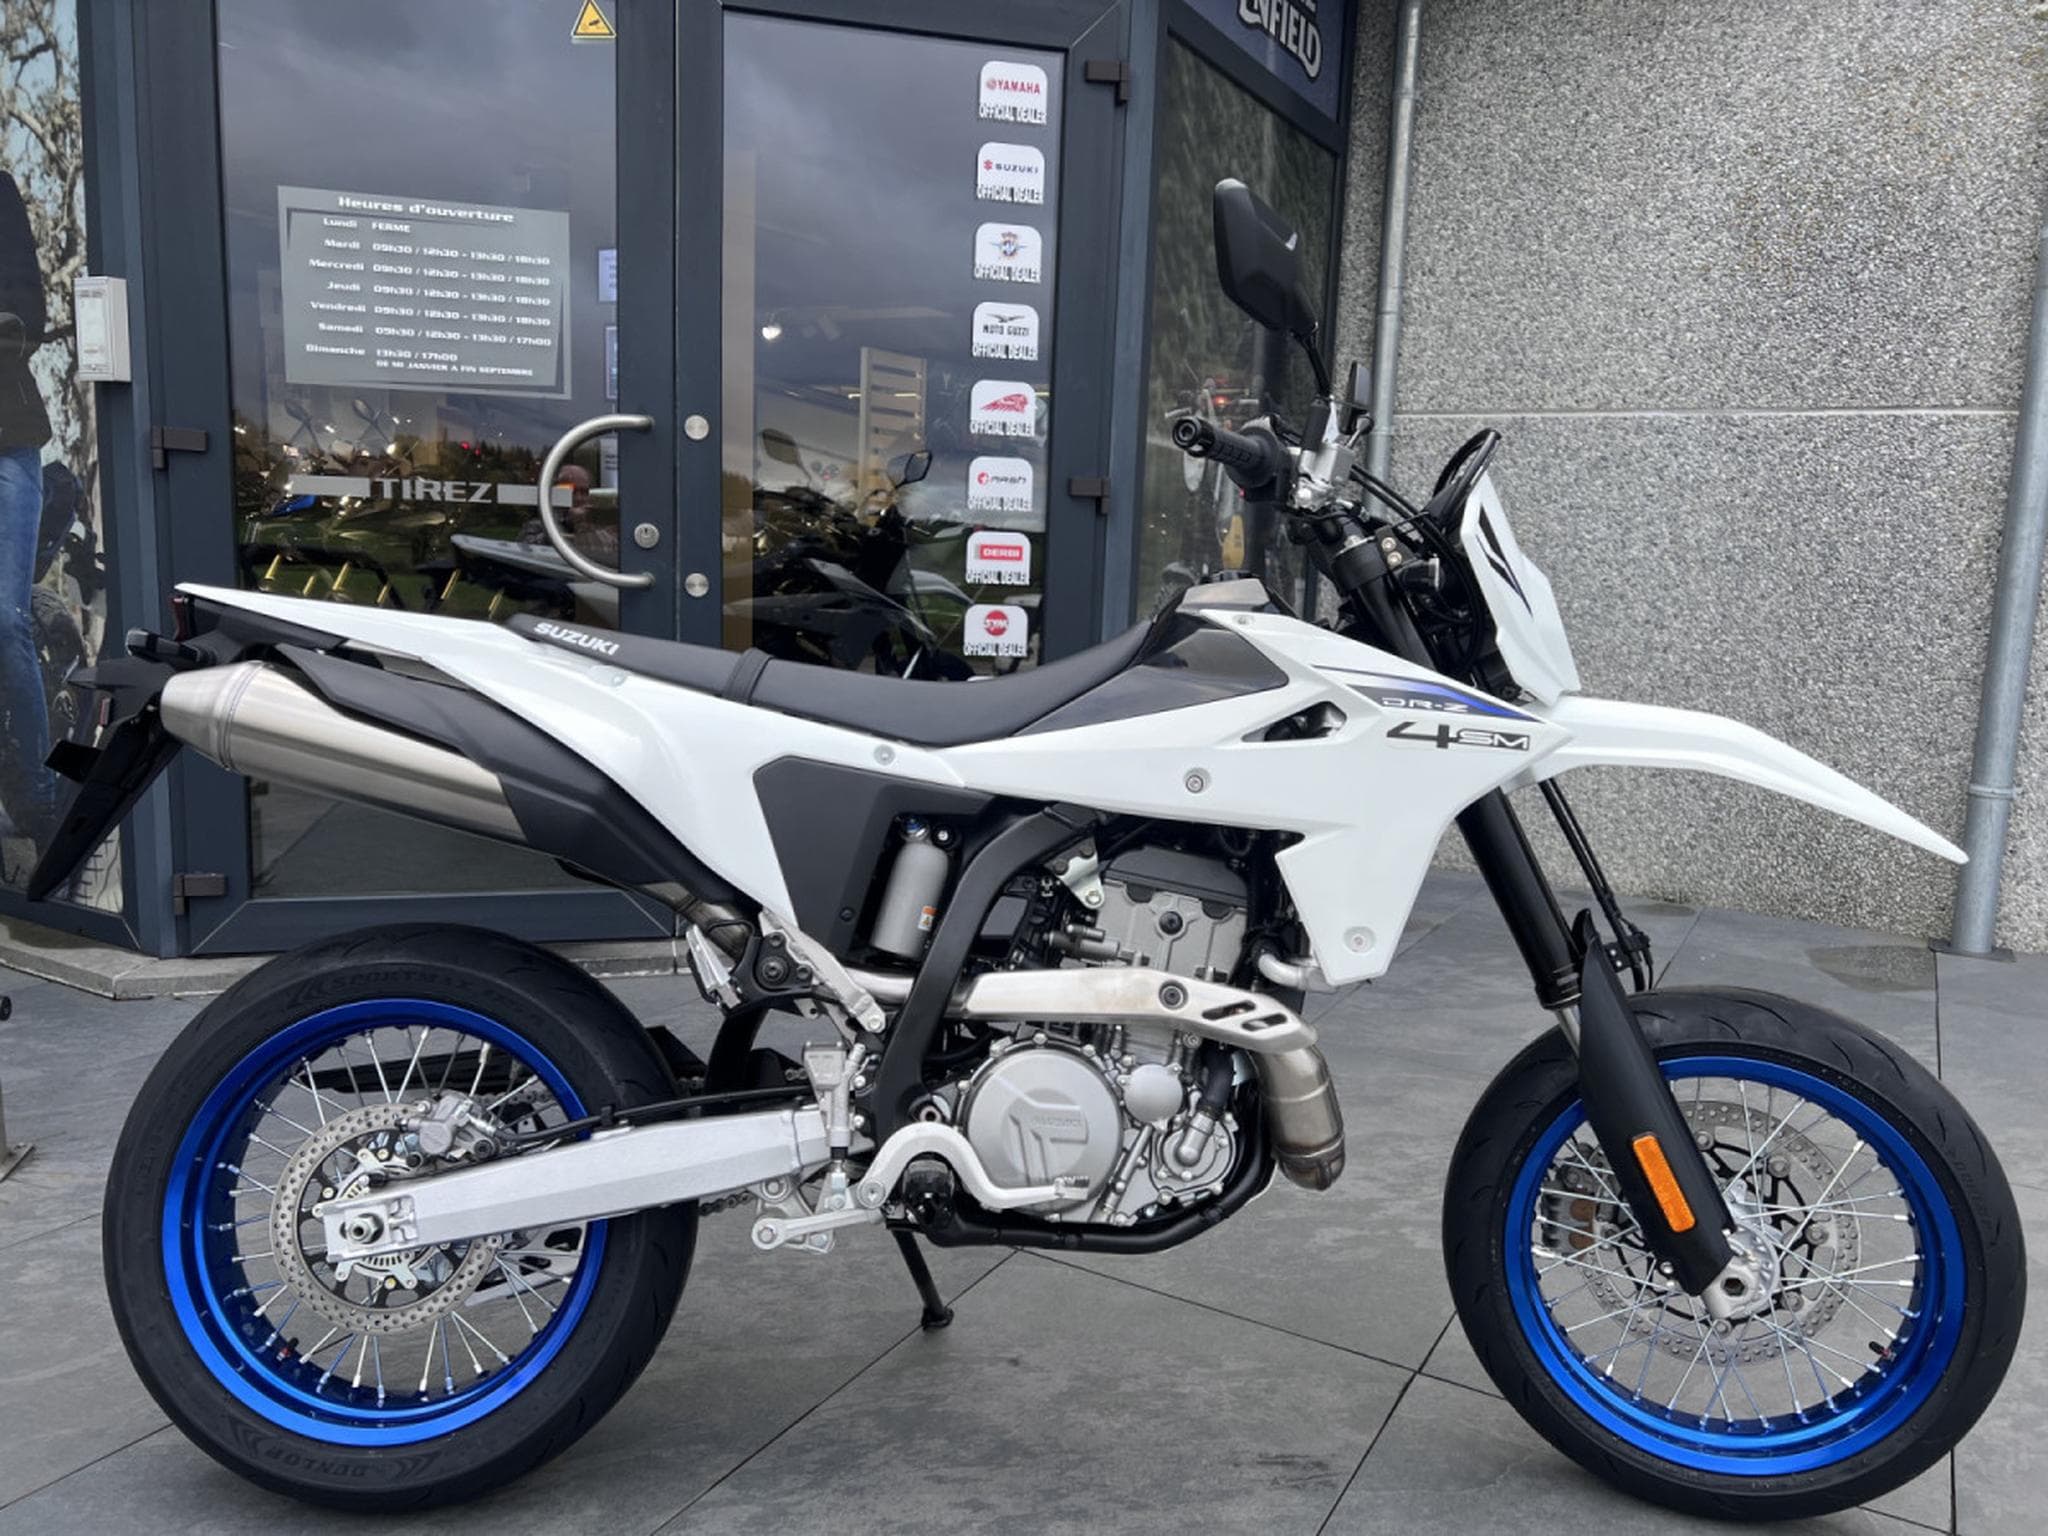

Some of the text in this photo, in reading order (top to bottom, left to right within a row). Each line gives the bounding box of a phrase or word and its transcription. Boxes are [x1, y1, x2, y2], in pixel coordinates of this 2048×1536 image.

[997, 80, 1041, 94] YAMAHA
[979, 103, 1047, 124] OFFICIAL DEALER
[995, 163, 1038, 174] SUZUKI
[976, 184, 1043, 204] OFFICIAL DEALER
[338, 196, 515, 222] Heures d'ouverture
[323, 218, 357, 228] Lundi
[324, 239, 360, 250] Mardi
[423, 246, 459, 258] 12h30
[470, 250, 505, 261] 13h30
[309, 259, 364, 271] Mercredi
[423, 267, 459, 278] 12h30
[470, 271, 505, 282] 13h30
[975, 265, 1041, 283] OFFICIAL DEALER
[327, 280, 360, 292] Jeudi
[423, 288, 459, 299] 12h30
[471, 291, 505, 302] 13h30
[310, 301, 366, 313] Vendredi
[424, 308, 459, 319] 12h30
[471, 311, 505, 322] 13h30
[318, 323, 363, 333] Samedi
[425, 329, 461, 340] 12h30
[472, 332, 506, 342] 13h30
[983, 324, 1004, 335] MOTO
[306, 343, 365, 355] Dimanche
[421, 351, 458, 362] 17h00
[972, 342, 1038, 361] OFFICIAL DEALER
[970, 418, 1034, 437] OFFICIAL DEALER
[373, 477, 492, 503] TIREZ
[983, 546, 1020, 559] DERBI
[534, 622, 619, 655] SUZUKI
[1382, 697, 1469, 713] DR-Z
